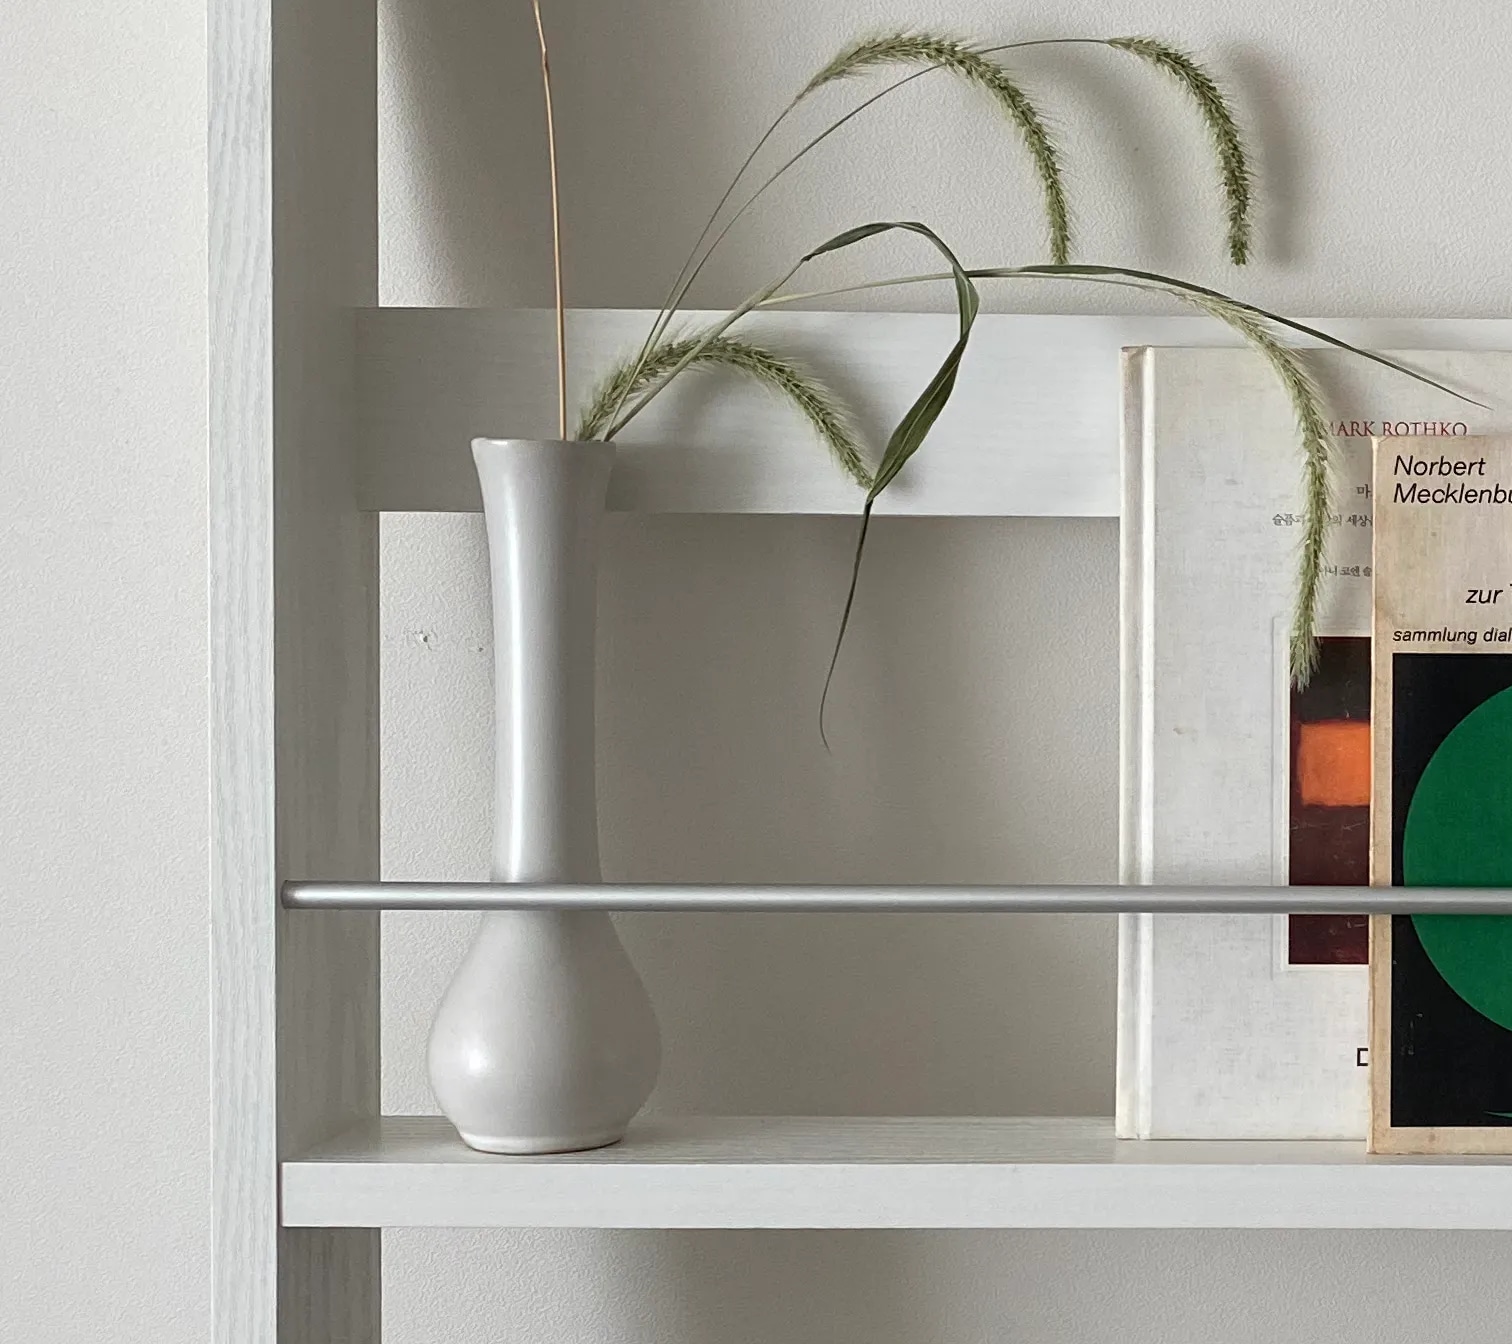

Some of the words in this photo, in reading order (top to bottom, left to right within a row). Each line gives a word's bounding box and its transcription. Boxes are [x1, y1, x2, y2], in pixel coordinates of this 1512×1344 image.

[1382, 421, 1468, 436] ROTHKO
[1394, 455, 1486, 476] Norbert
[1356, 484, 1372, 498] 마
[1466, 590, 1503, 604] zur
[1393, 627, 1477, 645] sammlung
